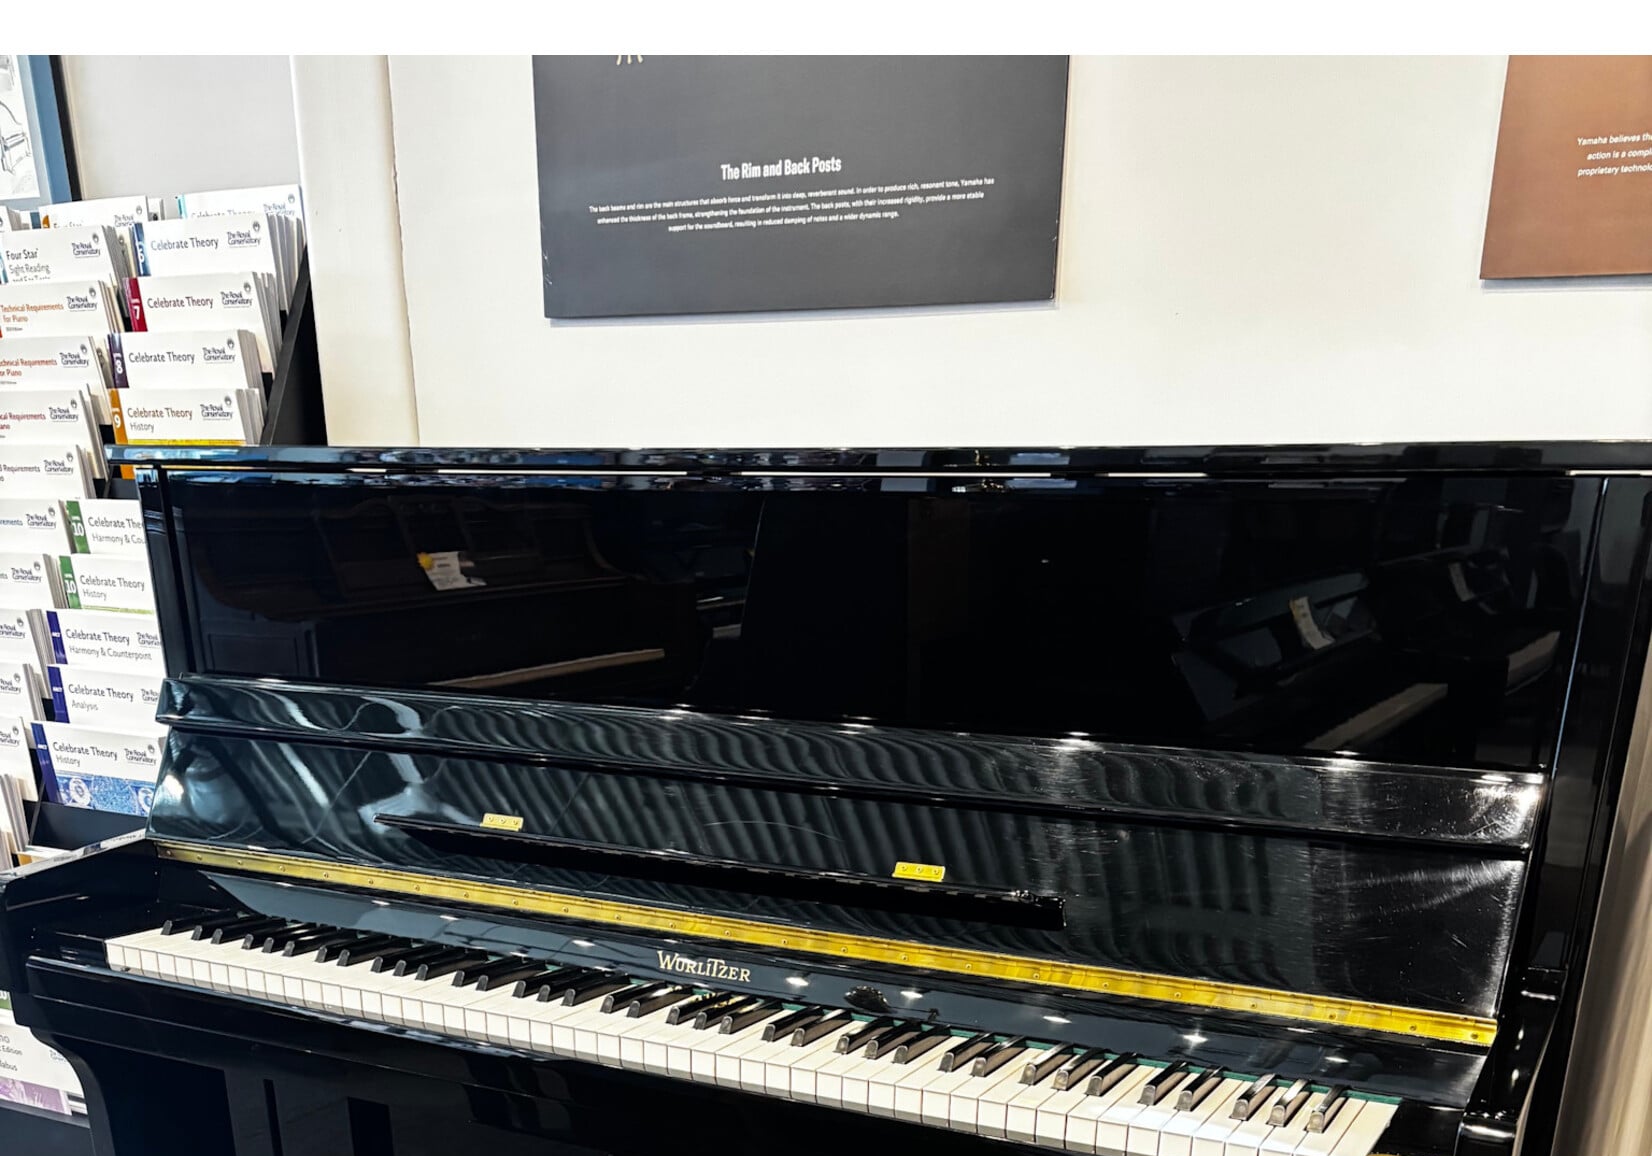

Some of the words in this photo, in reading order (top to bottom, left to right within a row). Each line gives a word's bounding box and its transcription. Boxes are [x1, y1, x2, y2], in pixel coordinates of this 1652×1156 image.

[1578, 136, 1607, 146] Yamaha
[1609, 134, 1641, 144] believes
[1587, 152, 1611, 161] action
[1612, 150, 1619, 158] is
[721, 164, 740, 180] The
[742, 162, 761, 180] Rim
[763, 160, 782, 178] and
[784, 158, 810, 175] Back
[812, 156, 842, 174] Posts
[1577, 166, 1619, 177] proprietary
[150, 238, 189, 251] Celebrate
[190, 238, 219, 250] Theory
[228, 238, 261, 246] Conservatory
[6, 250, 22, 261] Four
[25, 264, 51, 275] Reading
[26, 304, 64, 313] Requirements
[147, 298, 184, 309] Celebrate
[185, 296, 213, 309] Theory
[20, 359, 58, 368] Requirements
[129, 353, 165, 363] Celebrate
[166, 352, 195, 364] Theory
[116, 359, 123, 374] 8
[8, 412, 46, 422] Requirements
[127, 408, 164, 418] Celebrate
[165, 407, 193, 420] Theory
[130, 422, 155, 433] History
[3, 464, 40, 474] Requirements
[88, 516, 125, 528] Celebrate
[92, 533, 124, 545] Harmony
[80, 575, 116, 587] Celebrate
[117, 578, 145, 591] Theory
[83, 589, 107, 601] History
[66, 629, 101, 641] Celebrate
[103, 632, 130, 646] Theory
[70, 646, 100, 658] Harmony
[107, 648, 152, 661] Counterpoint
[69, 684, 105, 697] Celebrate
[106, 688, 134, 702] Theory
[72, 700, 99, 712] Analysis
[53, 742, 90, 755] Celebrate
[90, 746, 118, 761] Theory
[56, 755, 81, 767] History
